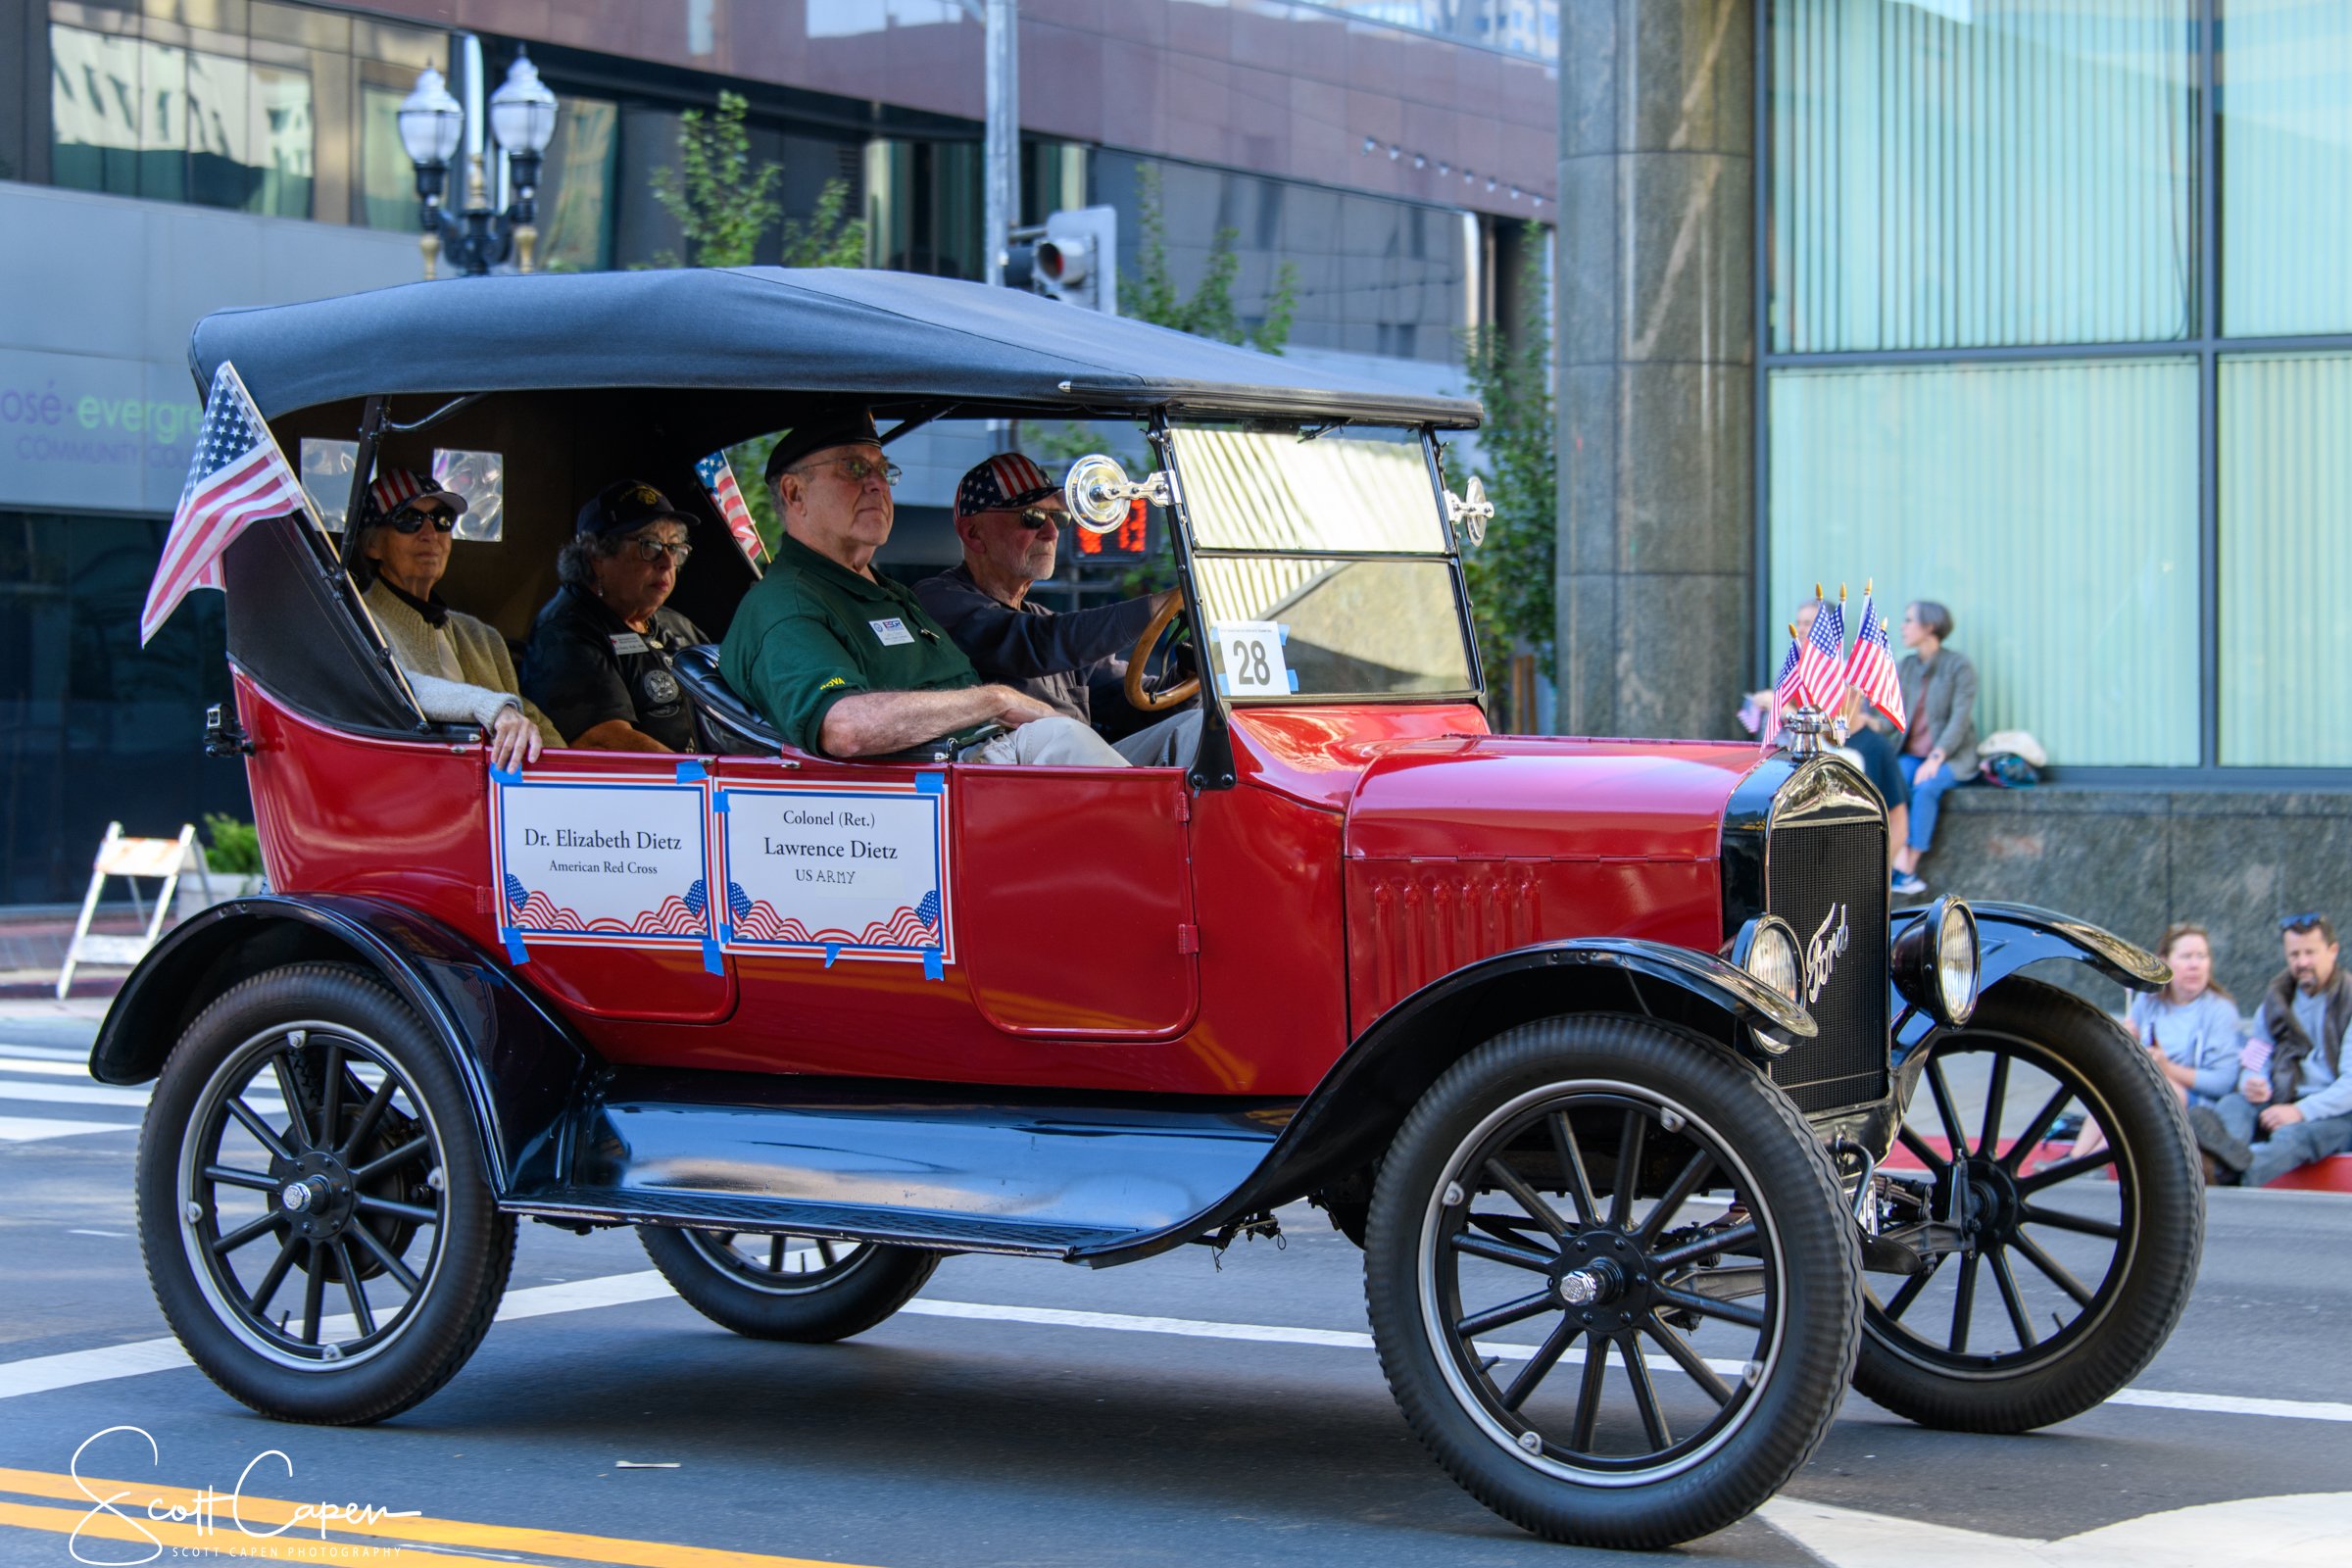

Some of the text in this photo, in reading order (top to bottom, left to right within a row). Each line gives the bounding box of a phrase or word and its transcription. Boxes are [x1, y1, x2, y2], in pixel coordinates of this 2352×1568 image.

[1233, 639, 1271, 686] 28
[783, 810, 875, 828] Colonel (Ret.)
[524, 828, 681, 850] Dr. Elizabeth Dietz
[764, 837, 898, 858] Lawrence Dietz
[549, 860, 658, 874] American Red Cross
[796, 869, 856, 884] US ARMY
[1805, 902, 1849, 1004] Ford
